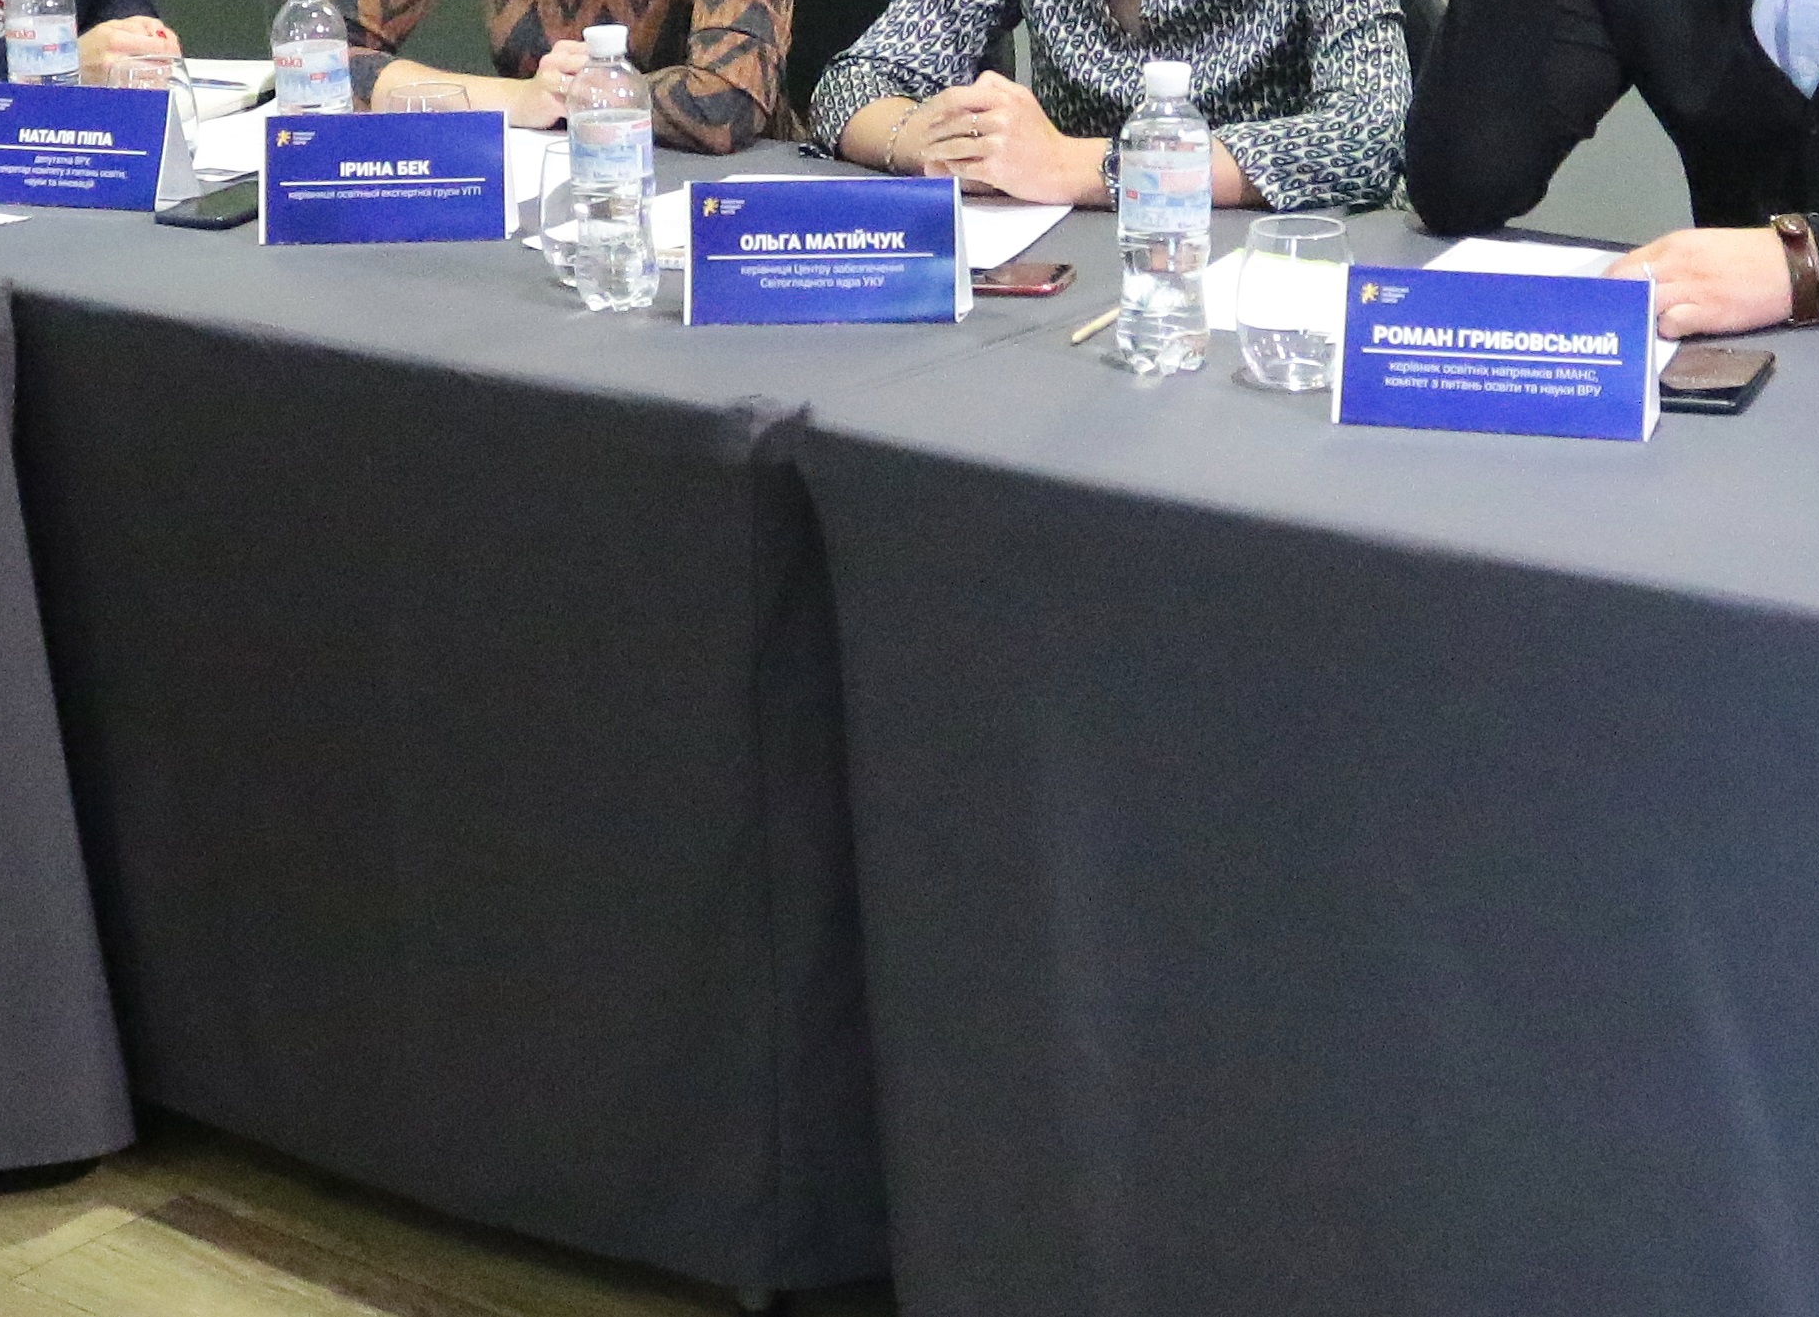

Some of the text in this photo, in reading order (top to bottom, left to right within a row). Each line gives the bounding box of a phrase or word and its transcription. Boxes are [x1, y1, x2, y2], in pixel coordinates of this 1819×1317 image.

[18, 127, 113, 146] НАТАЛЯ ПІПА
[339, 160, 430, 177] ІРИНА БЕК
[739, 227, 906, 251] ОЛЬГА МАТІЙЧУК
[1372, 324, 1618, 355] РОМАН ГРИБОВСЬКИЙ
